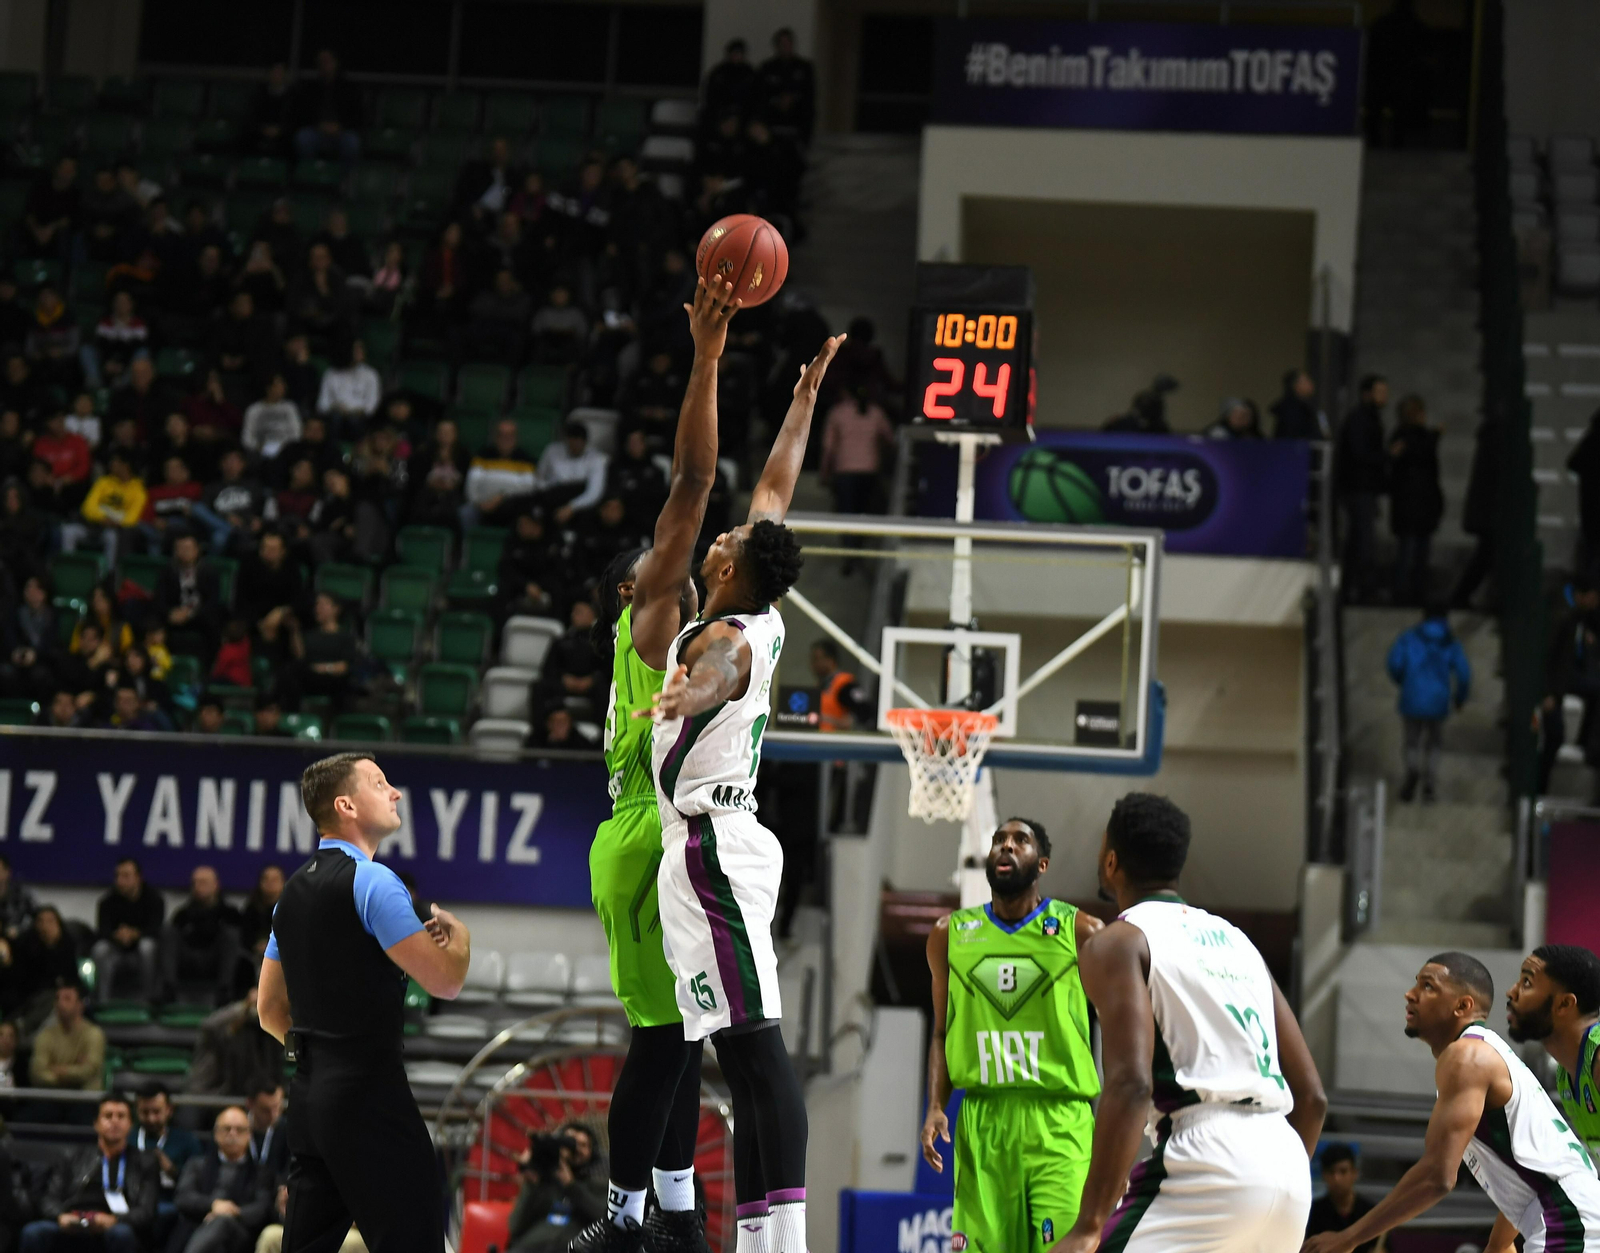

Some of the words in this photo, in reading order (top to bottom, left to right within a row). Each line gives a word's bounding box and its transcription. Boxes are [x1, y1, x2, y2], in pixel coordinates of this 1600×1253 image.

[934, 313, 1018, 350] 10:00
[923, 357, 1011, 419] 24
[96, 772, 544, 865] YANINAYIZ
[690, 970, 717, 1011] 15
[976, 1030, 1045, 1085] FIAT
